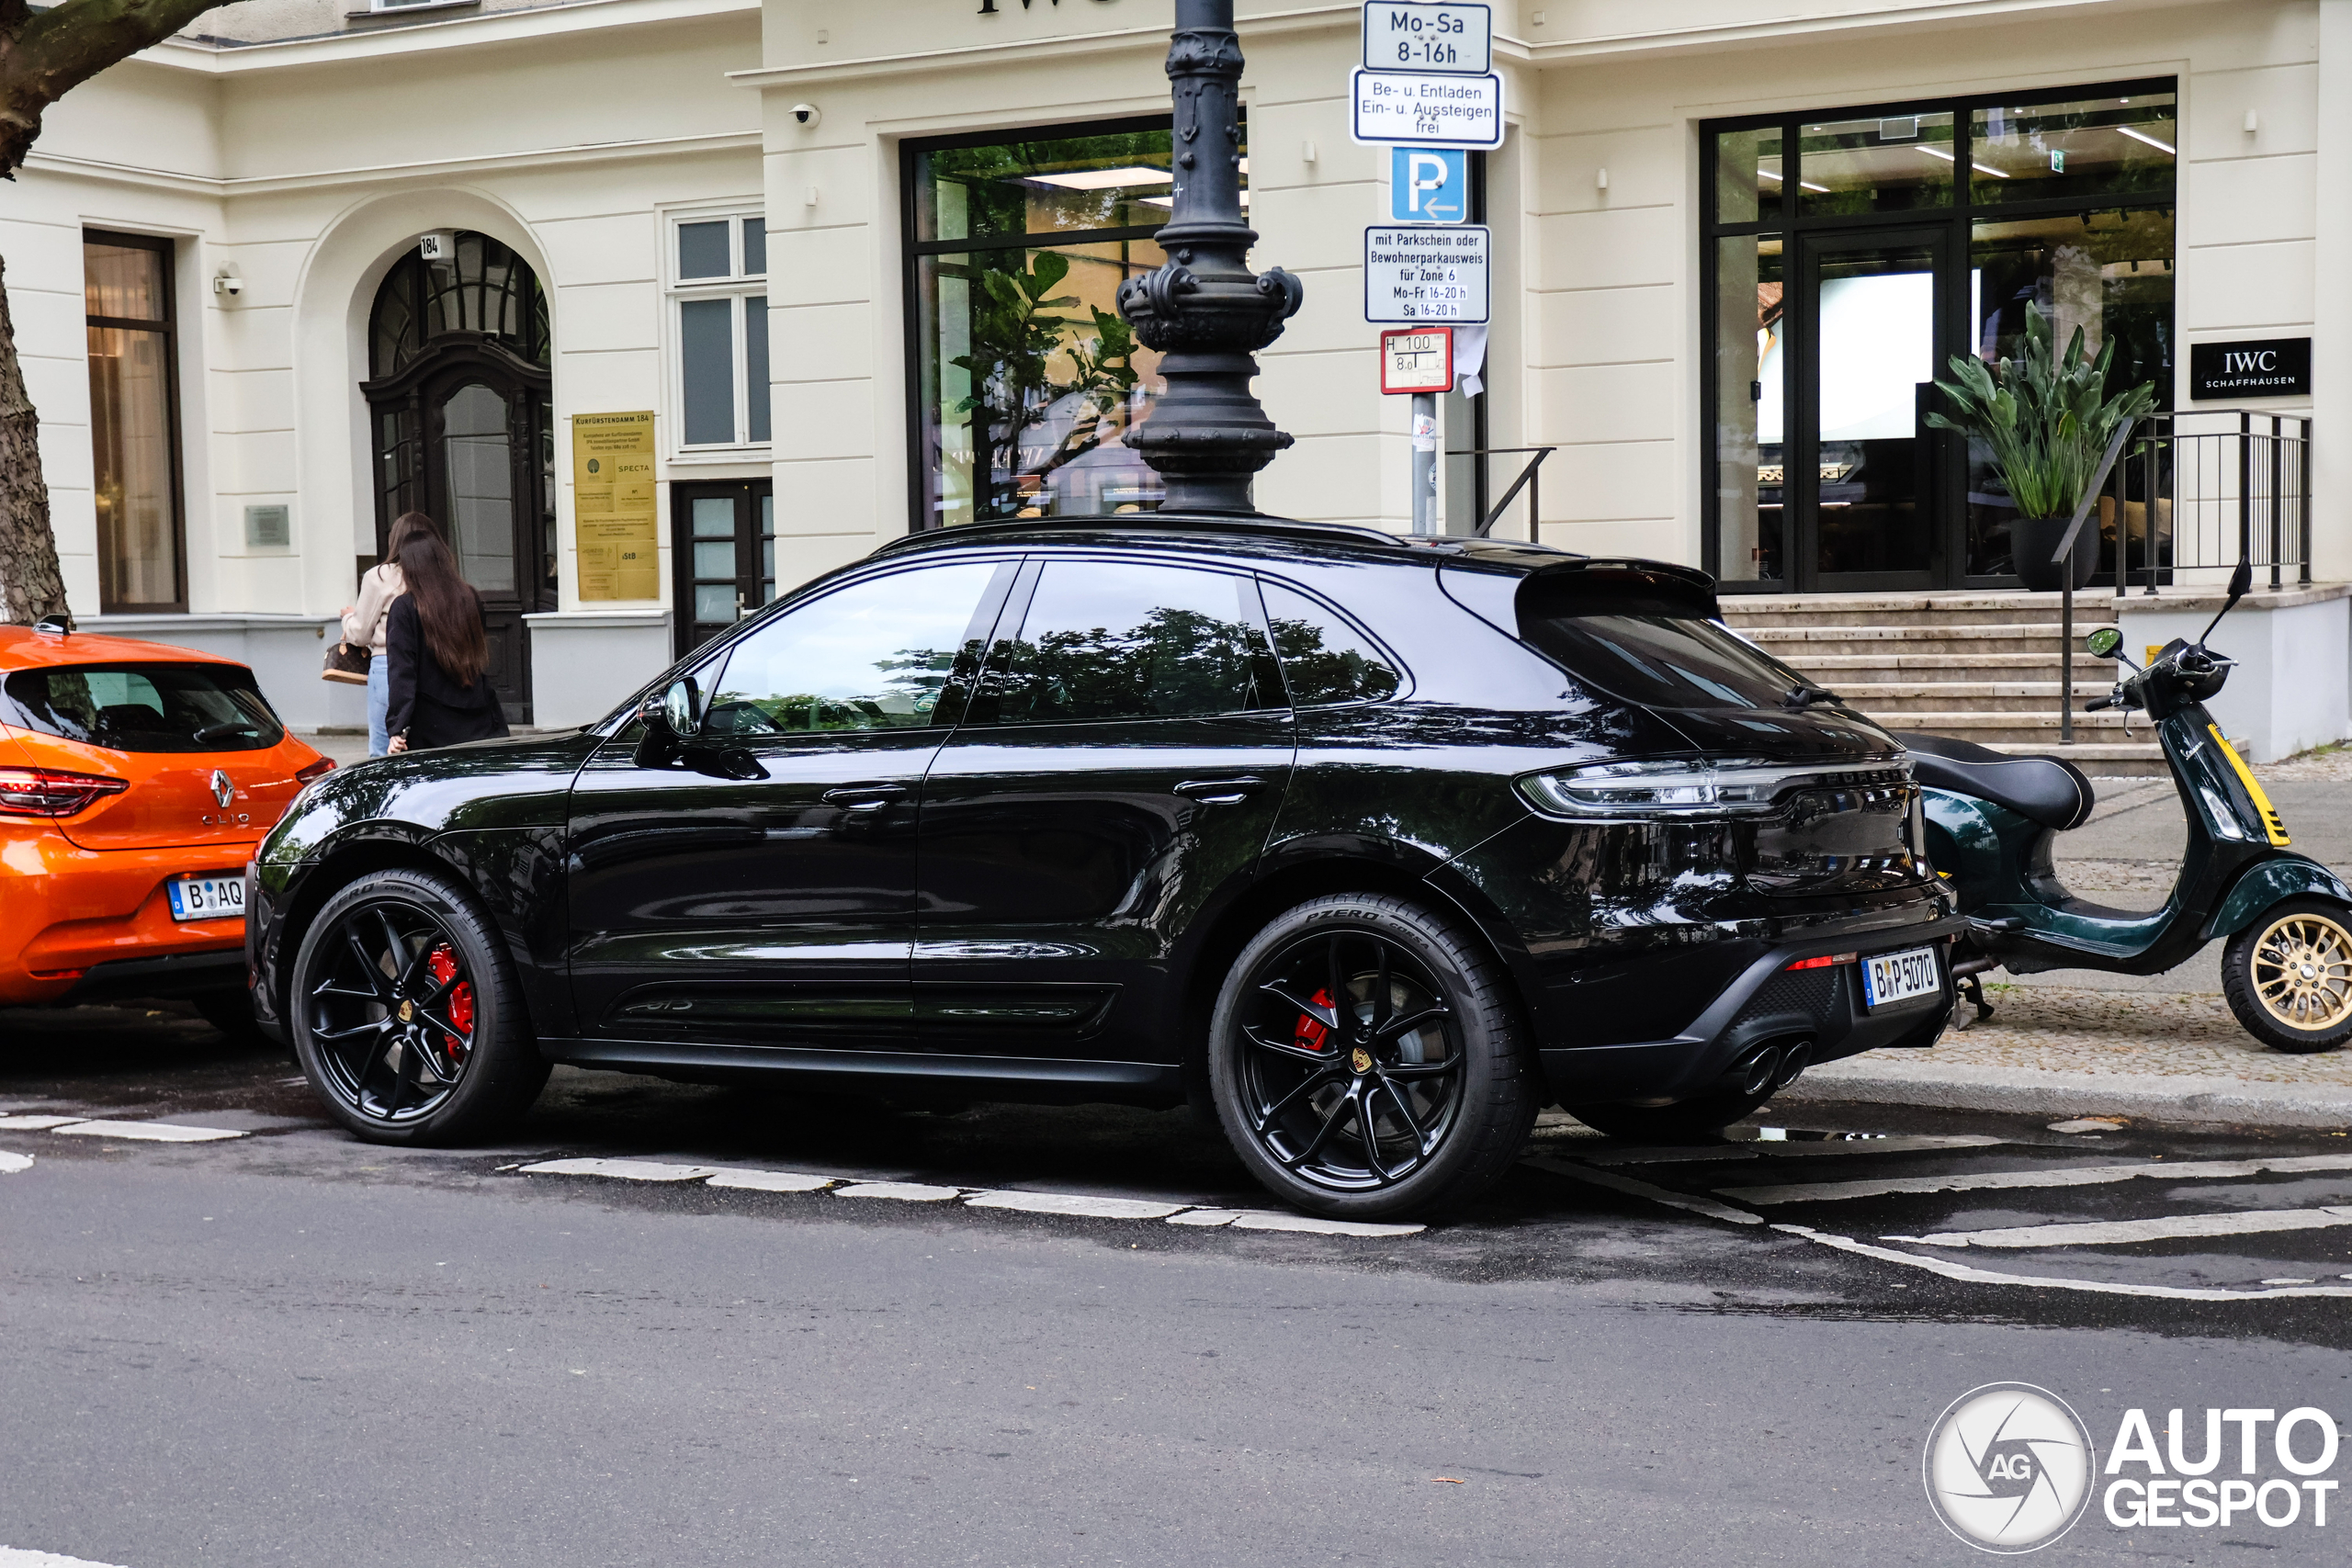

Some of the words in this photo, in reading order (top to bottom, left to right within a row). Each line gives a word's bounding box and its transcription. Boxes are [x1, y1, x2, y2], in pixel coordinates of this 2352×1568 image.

[1391, 11, 1464, 33] Mo-Sa
[1397, 41, 1456, 63] 8-16h
[1373, 83, 1398, 96] Be-
[1404, 85, 1416, 96] u.
[1420, 84, 1482, 99] Entladen
[1363, 100, 1391, 114] Ein-
[1396, 104, 1408, 115] u.
[1413, 102, 1492, 120] Aussteigen
[1416, 119, 1440, 133] frei
[1408, 153, 1448, 212] P
[422, 237, 438, 254] 184
[1375, 233, 1392, 245] mit
[1396, 233, 1452, 246] Parkschein
[1456, 235, 1479, 247] oder
[1371, 251, 1484, 266] Bewohnerparkausweis
[1399, 269, 1415, 281] für
[1420, 269, 1443, 281] Zone
[1448, 269, 1455, 281] 6
[1393, 287, 1425, 299] Mo-Fr
[1430, 287, 1457, 299] 16-20
[1460, 287, 1466, 299] h
[1403, 304, 1416, 316] Sa
[1420, 304, 1448, 316] 16-20
[1451, 304, 1457, 316] h
[1386, 338, 1395, 351] H
[1406, 335, 1430, 350] 100
[2223, 350, 2277, 373] IWC
[2206, 377, 2295, 389] SCHAFFHAUSEN
[575, 416, 635, 425] KURFÜRSTENDAMM
[637, 414, 650, 423] 184
[618, 465, 650, 473] SPECTA
[202, 813, 250, 825] CLIO
[188, 885, 204, 908] B
[218, 881, 243, 907] AQ
[384, 885, 416, 895] CORSA
[1389, 922, 1430, 950] CORSA
[1875, 964, 1886, 998] B
[1891, 960, 1901, 994] P
[1902, 953, 1934, 992] 5070
